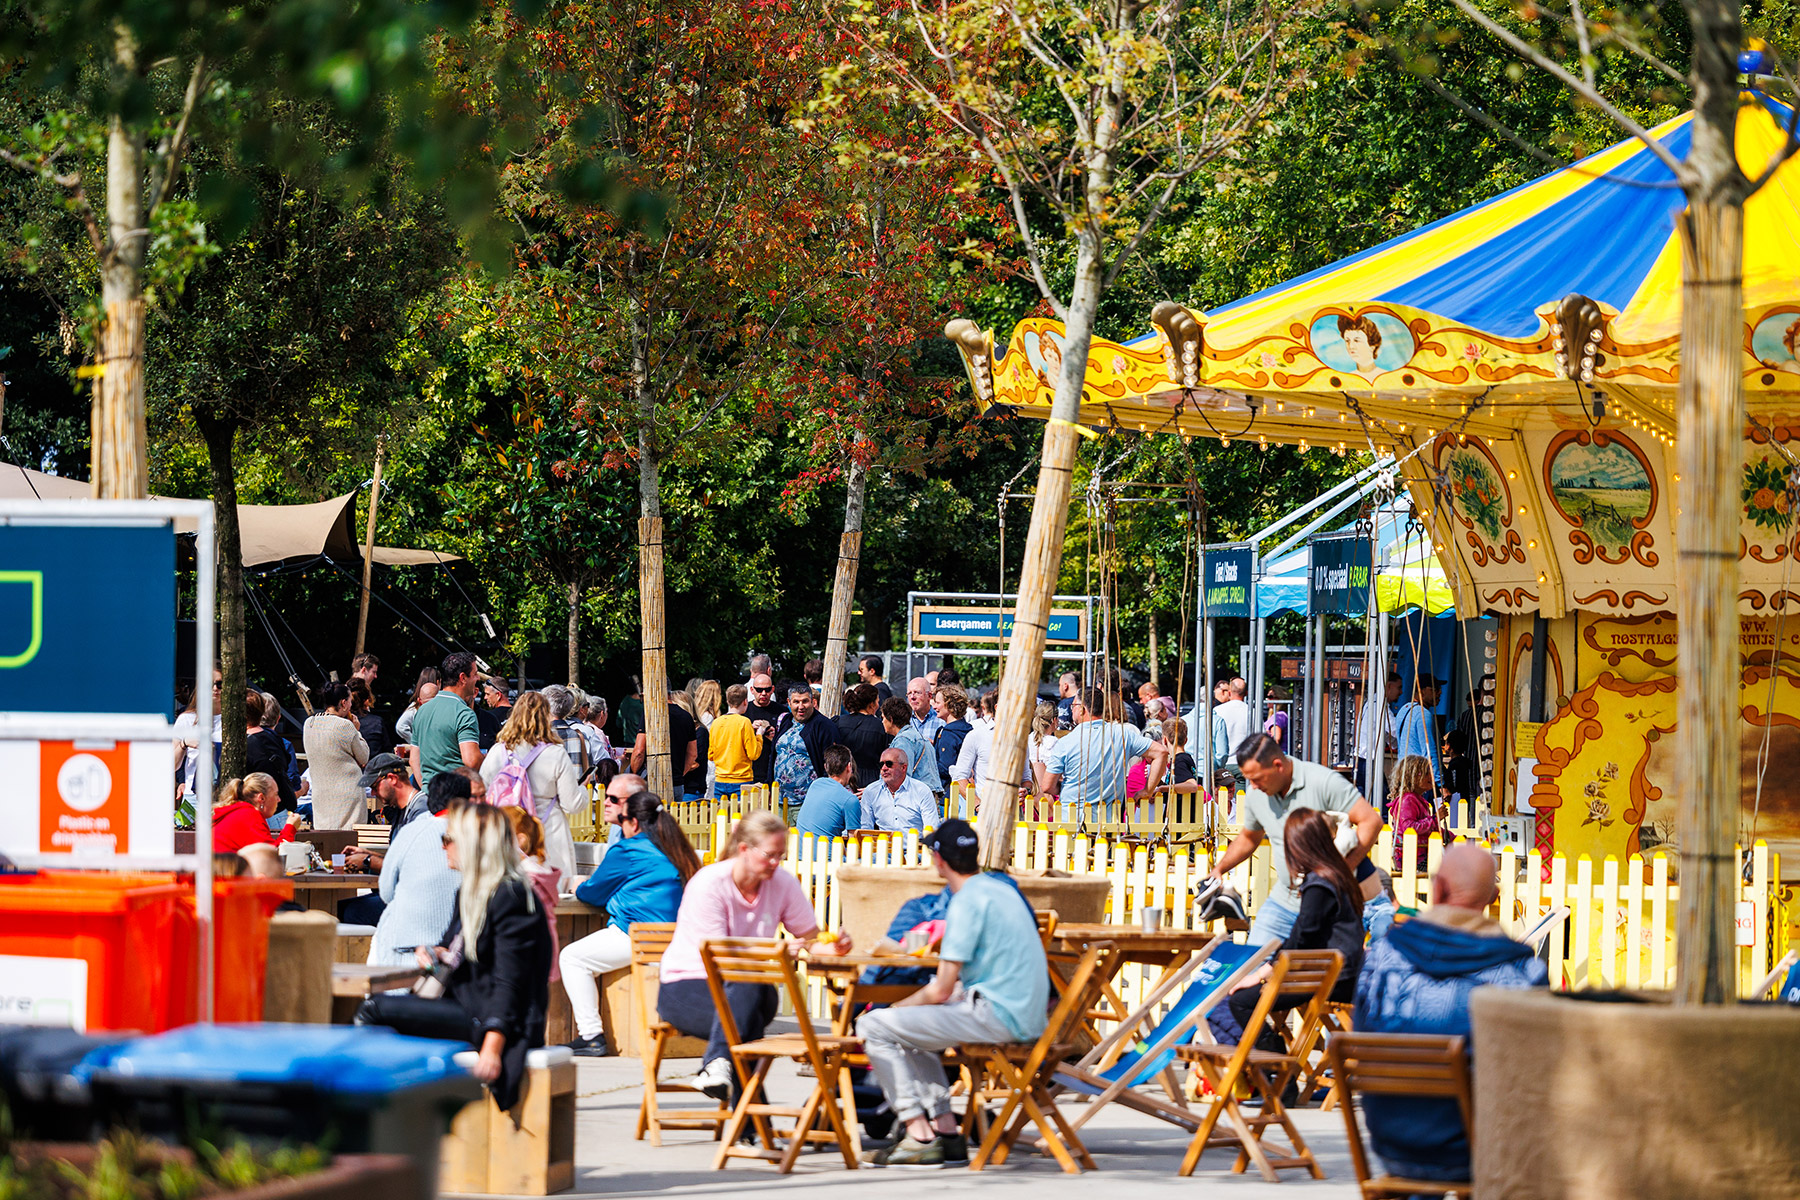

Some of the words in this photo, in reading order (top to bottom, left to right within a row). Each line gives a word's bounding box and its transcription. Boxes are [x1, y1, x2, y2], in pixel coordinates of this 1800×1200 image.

[935, 617, 993, 632] Lasergamen
[1048, 622, 1062, 632] GO!
[1610, 633, 1679, 646] NOSTALGI
[1738, 633, 1776, 646] RMIS
